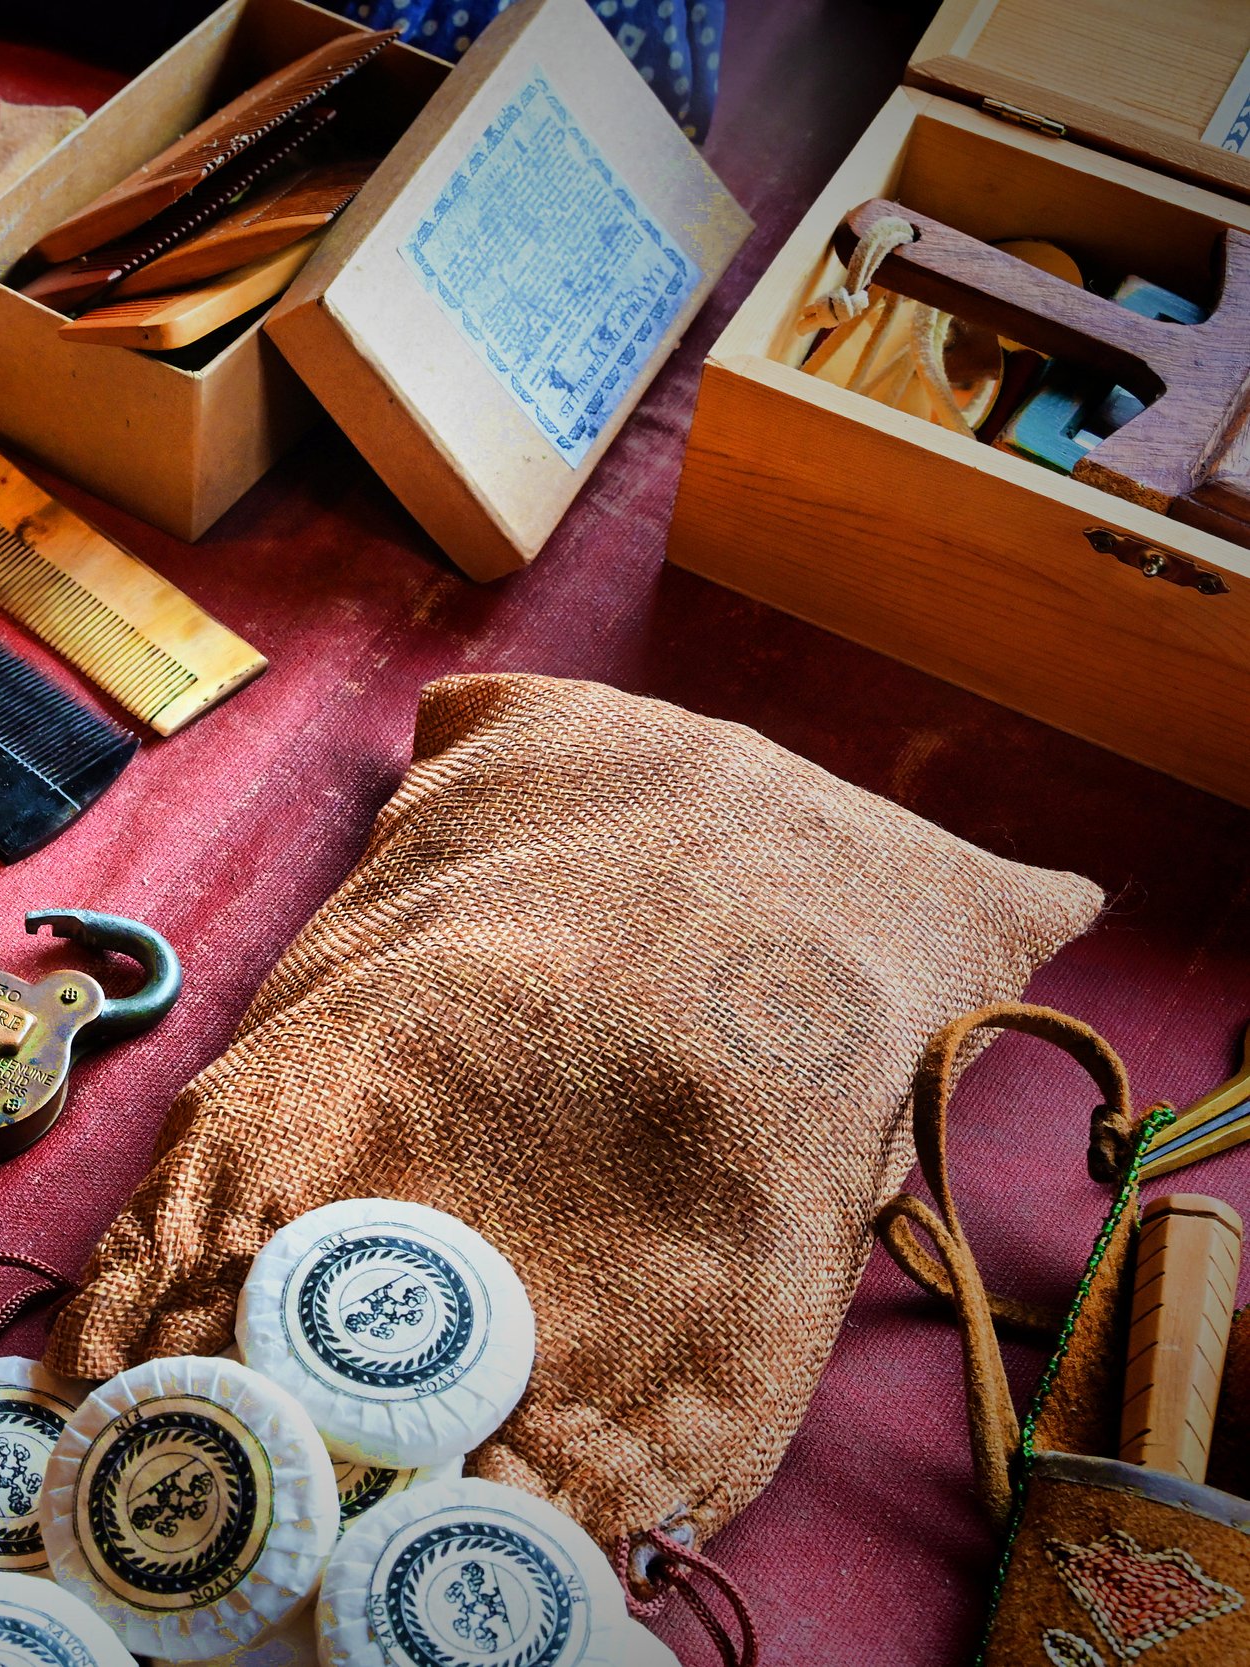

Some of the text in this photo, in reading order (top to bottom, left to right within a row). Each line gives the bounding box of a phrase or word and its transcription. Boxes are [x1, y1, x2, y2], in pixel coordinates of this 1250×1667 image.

[617, 290, 647, 333] VILLE
[0, 1058, 56, 1088] GENUINE
[318, 1232, 348, 1254] FIN
[413, 1361, 465, 1397] SAVON
[113, 1408, 144, 1436] FIN
[189, 1562, 242, 1604] SAVON
[563, 1572, 581, 1604] FIN
[369, 1593, 399, 1650] SAVON
